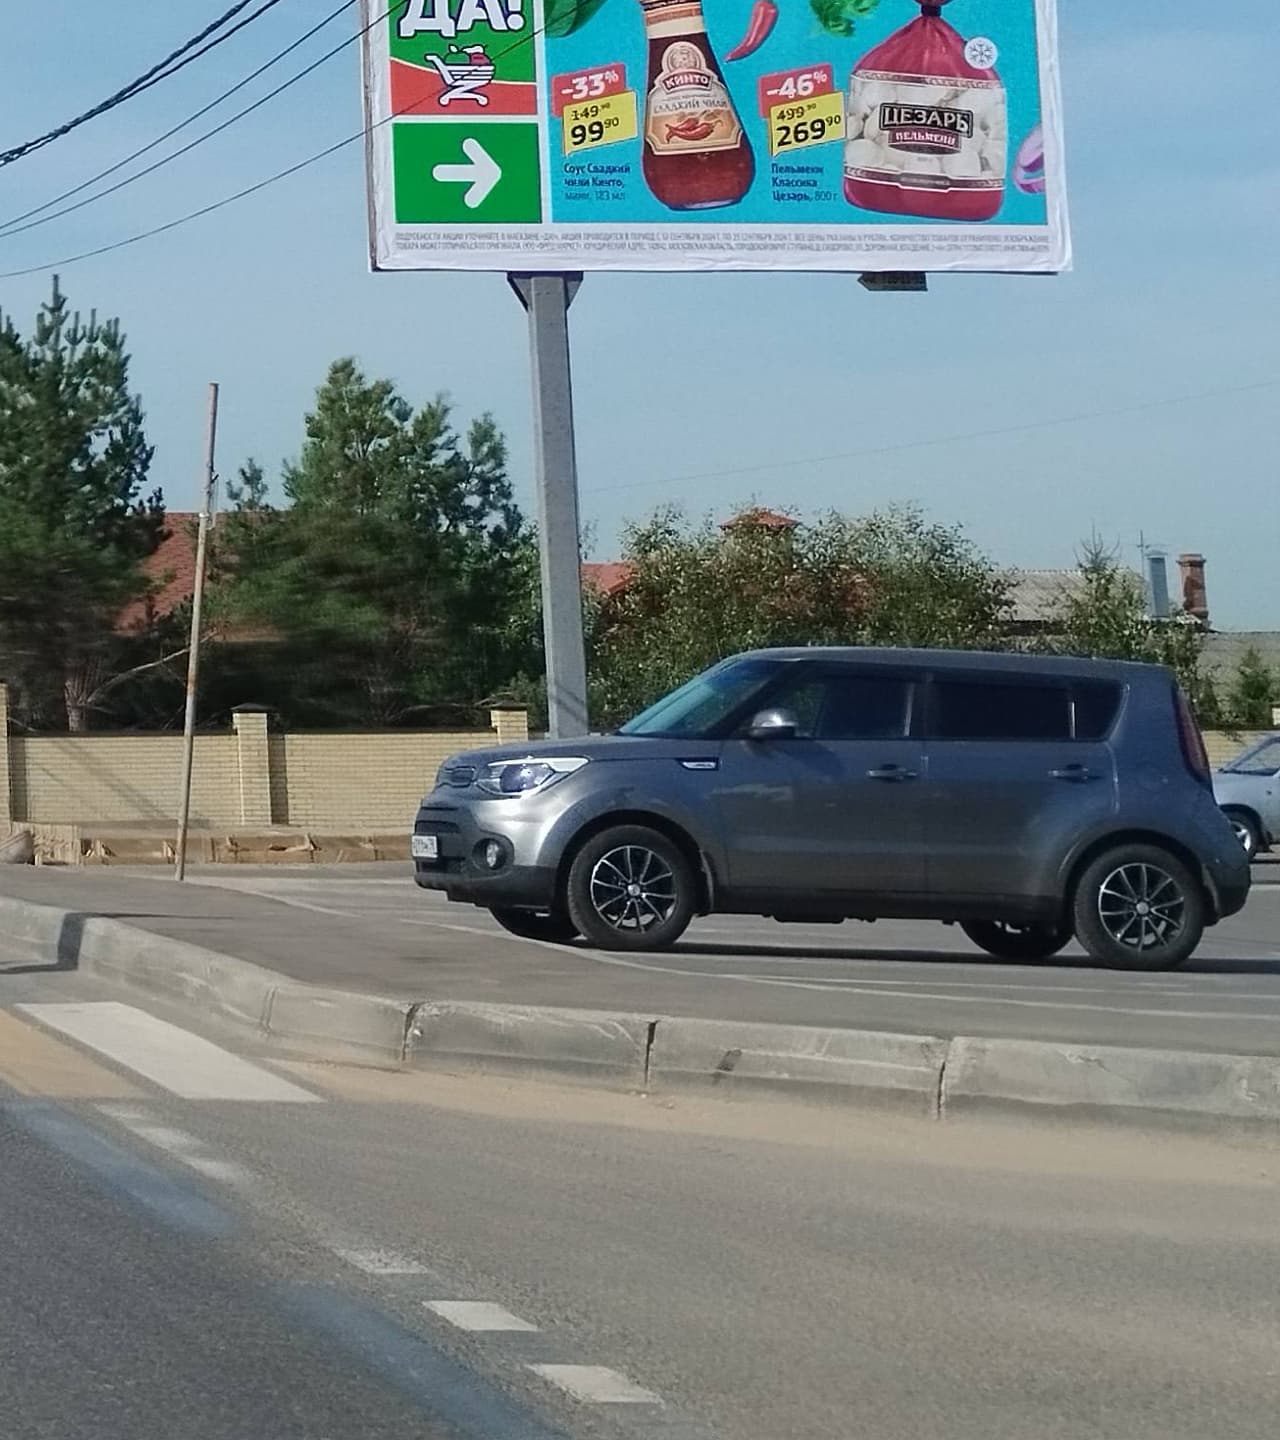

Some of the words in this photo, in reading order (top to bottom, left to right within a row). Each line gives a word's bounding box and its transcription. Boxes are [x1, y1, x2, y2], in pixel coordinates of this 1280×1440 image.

[561, 69, 620, 100] -33%
[665, 73, 709, 89] КИНТО
[766, 69, 828, 99] -46%
[883, 107, 969, 133] ЦЕЗАРЬ
[564, 163, 585, 175] Соус
